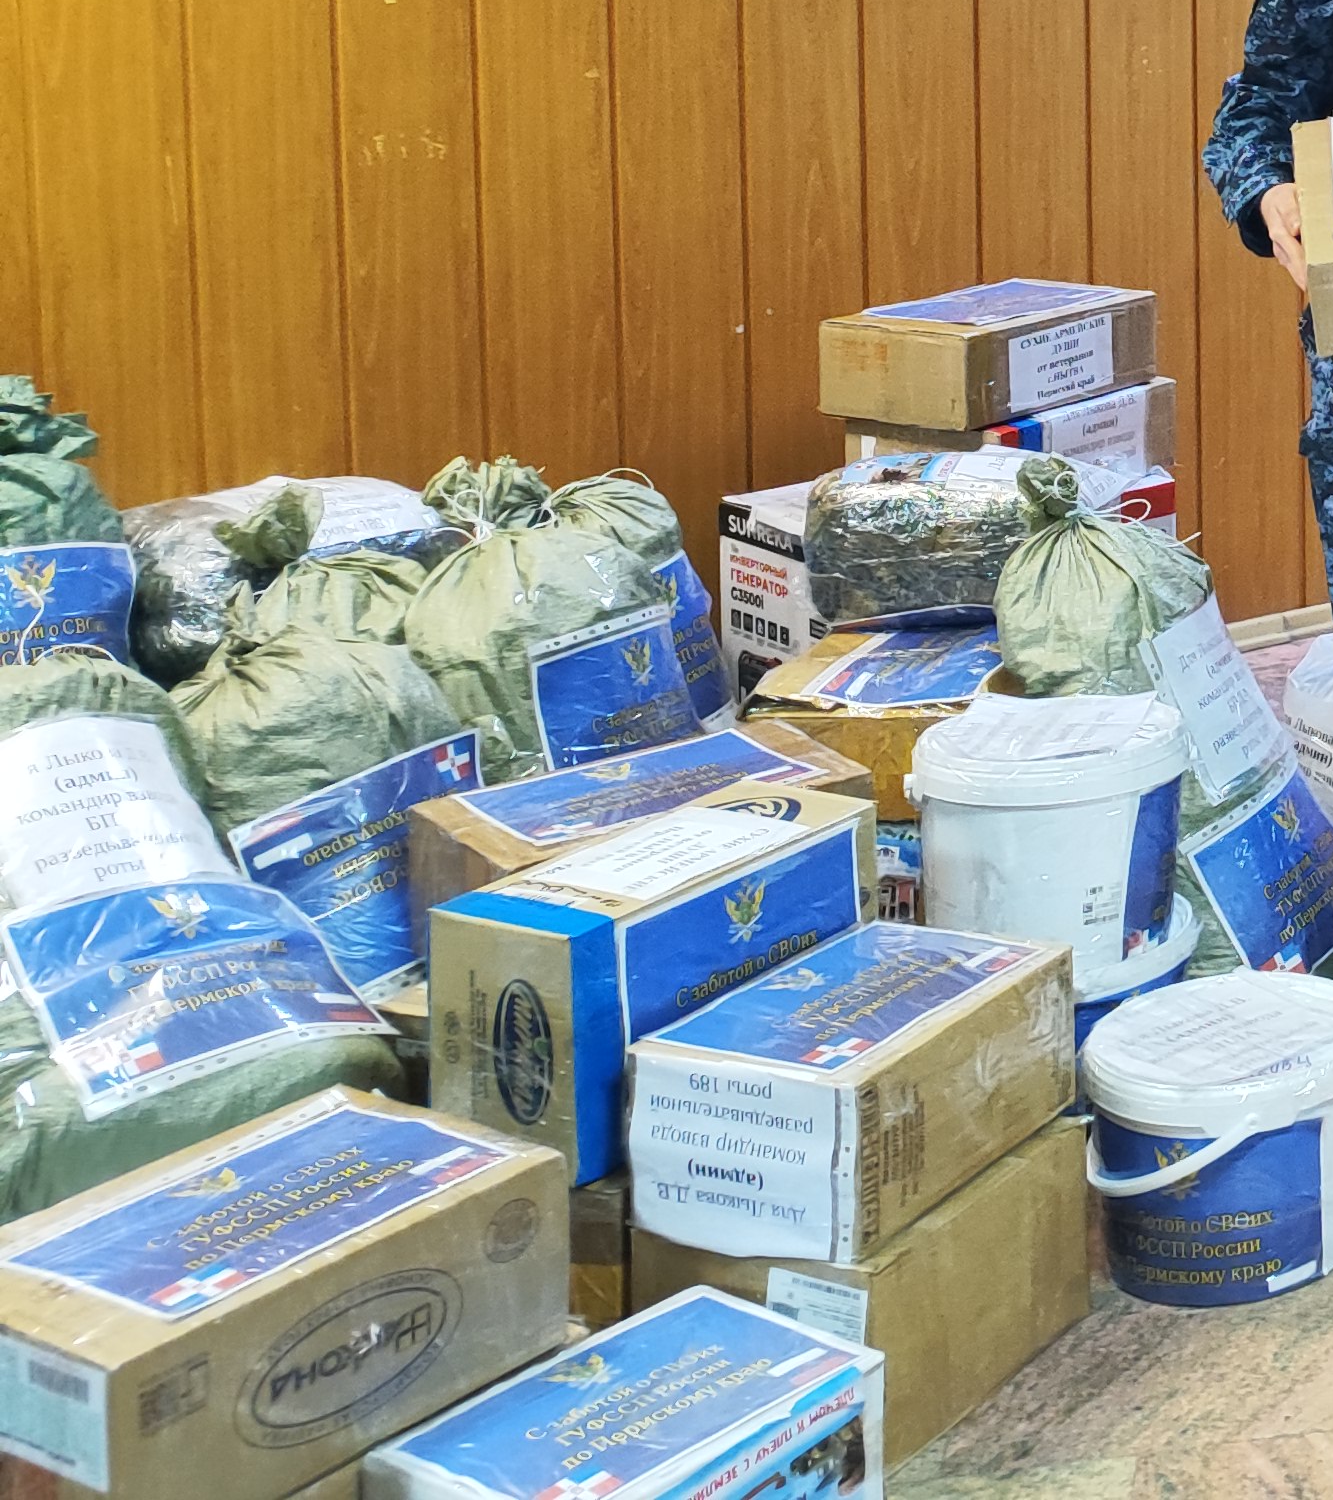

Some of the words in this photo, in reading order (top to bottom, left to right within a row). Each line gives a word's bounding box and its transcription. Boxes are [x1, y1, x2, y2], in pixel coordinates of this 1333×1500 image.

[1020, 336, 1051, 350] СУХИЕ
[1055, 316, 1106, 341] АРМЕЙСКИЕ
[1037, 364, 1047, 374] от
[1049, 350, 1094, 370] ветеранов
[1037, 382, 1076, 400] Пермский
[1078, 375, 1095, 391] край
[729, 553, 787, 581] ИНВЕРТОРНЫЙ
[730, 568, 788, 598] ГЕНЕРАТОР
[16, 790, 123, 825] командир
[302, 833, 358, 867] краю
[721, 827, 771, 851] СУХИЕ
[1263, 884, 1275, 900] С
[1280, 925, 1295, 944] по
[676, 987, 688, 1008] С
[691, 958, 754, 1002] заботой
[756, 954, 765, 971] о
[767, 929, 819, 965] СВОих
[688, 1072, 720, 1093] 189
[727, 1078, 773, 1097] роты
[649, 1094, 814, 1134] разведывательной
[650, 1124, 710, 1150] взвода
[716, 1132, 807, 1166] командир
[687, 1158, 764, 1192] (админ)
[147, 1236, 170, 1249] С
[177, 1190, 267, 1237] заботой
[268, 1182, 285, 1193] о
[283, 1145, 365, 1184] СВОих
[178, 1198, 291, 1252] ГУФССП
[284, 1161, 372, 1201] России
[650, 1180, 691, 1204] Д.В.
[696, 1189, 765, 1218] Лыкова
[183, 1252, 217, 1271] по
[215, 1187, 355, 1256] Пермскому
[353, 1159, 414, 1190] краю
[771, 1206, 806, 1225] Для
[1190, 1220, 1200, 1235] о
[1205, 1210, 1274, 1234] СВОих
[1191, 1238, 1261, 1260] России
[1231, 1258, 1282, 1284] краю
[525, 1426, 547, 1440] С
[547, 1386, 635, 1429] заботой
[636, 1378, 650, 1388] о
[649, 1343, 724, 1380] СВОих
[554, 1394, 657, 1447] ГУФССП
[652, 1358, 732, 1397] России
[808, 1386, 855, 1425] ПЛЕЧОМ
[562, 1450, 593, 1471] по
[589, 1385, 717, 1452] Пермскому
[715, 1357, 773, 1388] краю
[797, 1420, 805, 1435] К
[754, 1429, 793, 1465] ПЛЕЧУ
[743, 1458, 750, 1471] С
